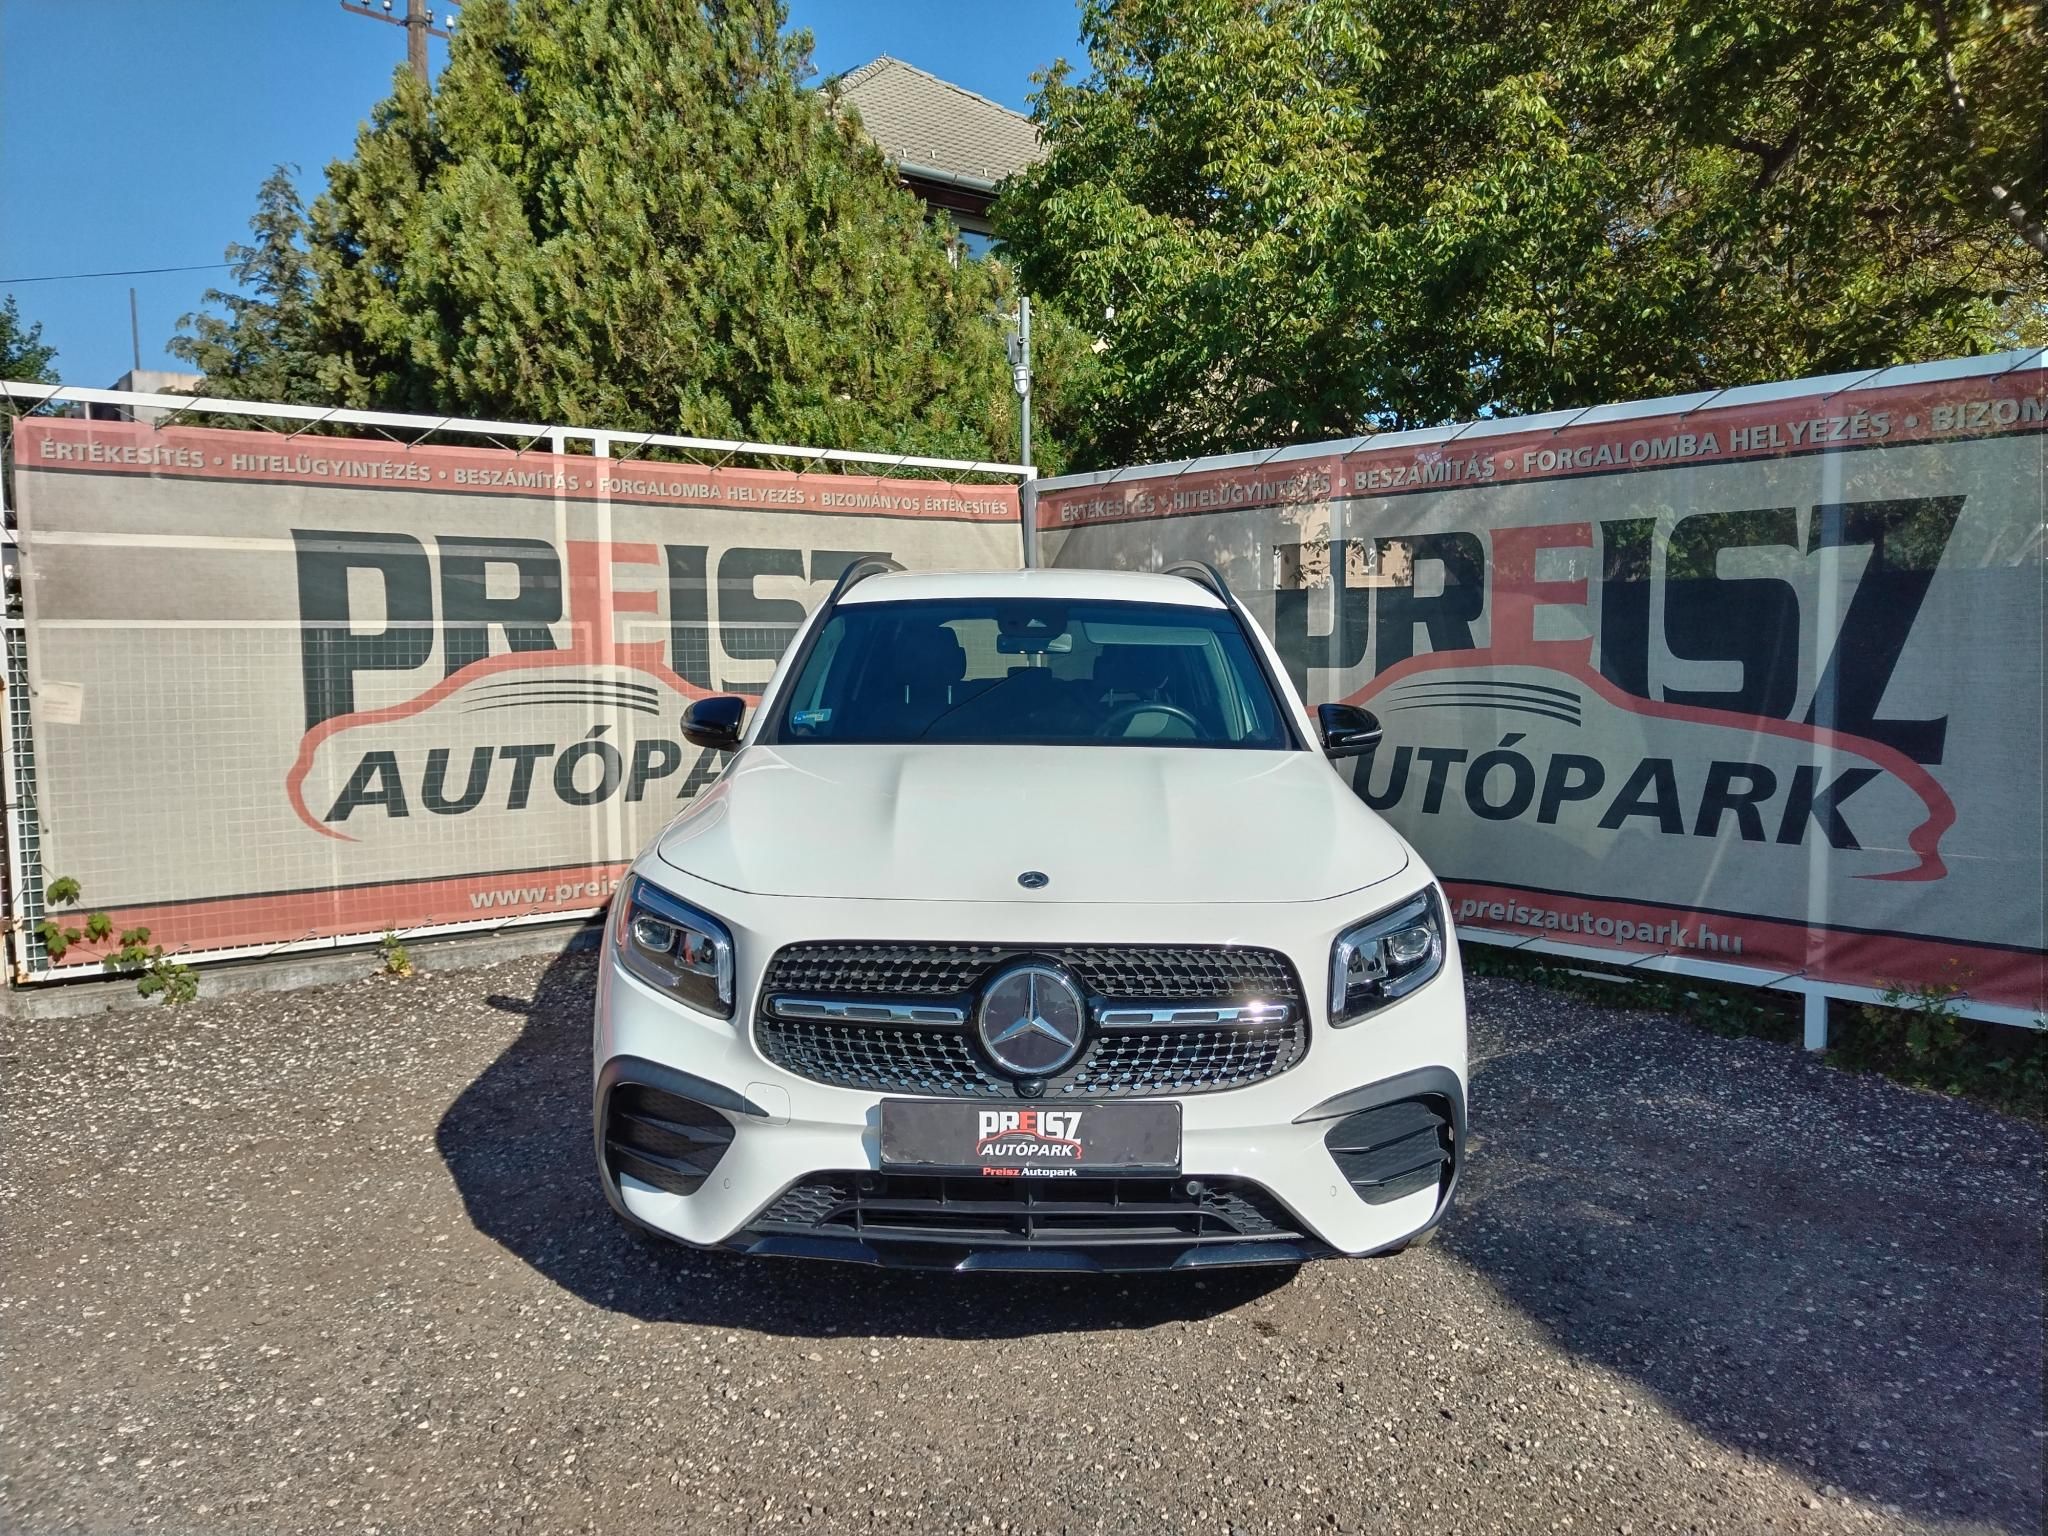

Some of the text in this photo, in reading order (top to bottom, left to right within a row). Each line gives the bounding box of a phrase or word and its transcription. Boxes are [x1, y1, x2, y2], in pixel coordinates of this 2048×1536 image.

[40, 438, 1008, 515] ÉRTÉKESÍTÉS HITELÜGYINTÉZÉS BESZÁMÍTÁS FORGALOMBA HELYEZÉS BIZOMÁNYOS ÉRTÉKESÍTÉS
[1061, 396, 2048, 522] ÉRTÉKESÍTÉS HITELÜGYINTÉZÉS BESZÁMÍTÁS FORGALOMBA HELYEZÉS BIZOM
[1272, 495, 1967, 765] PREISZ
[1350, 733, 1886, 851] UTÓPARK
[469, 875, 620, 909] www.preis
[1449, 898, 1742, 954] .preiszautopark.hu
[978, 1111, 1083, 1145] PREISZ
[980, 1141, 1074, 1157] AUTÓPARK
[983, 1167, 1078, 1178] Preisz Autopark
